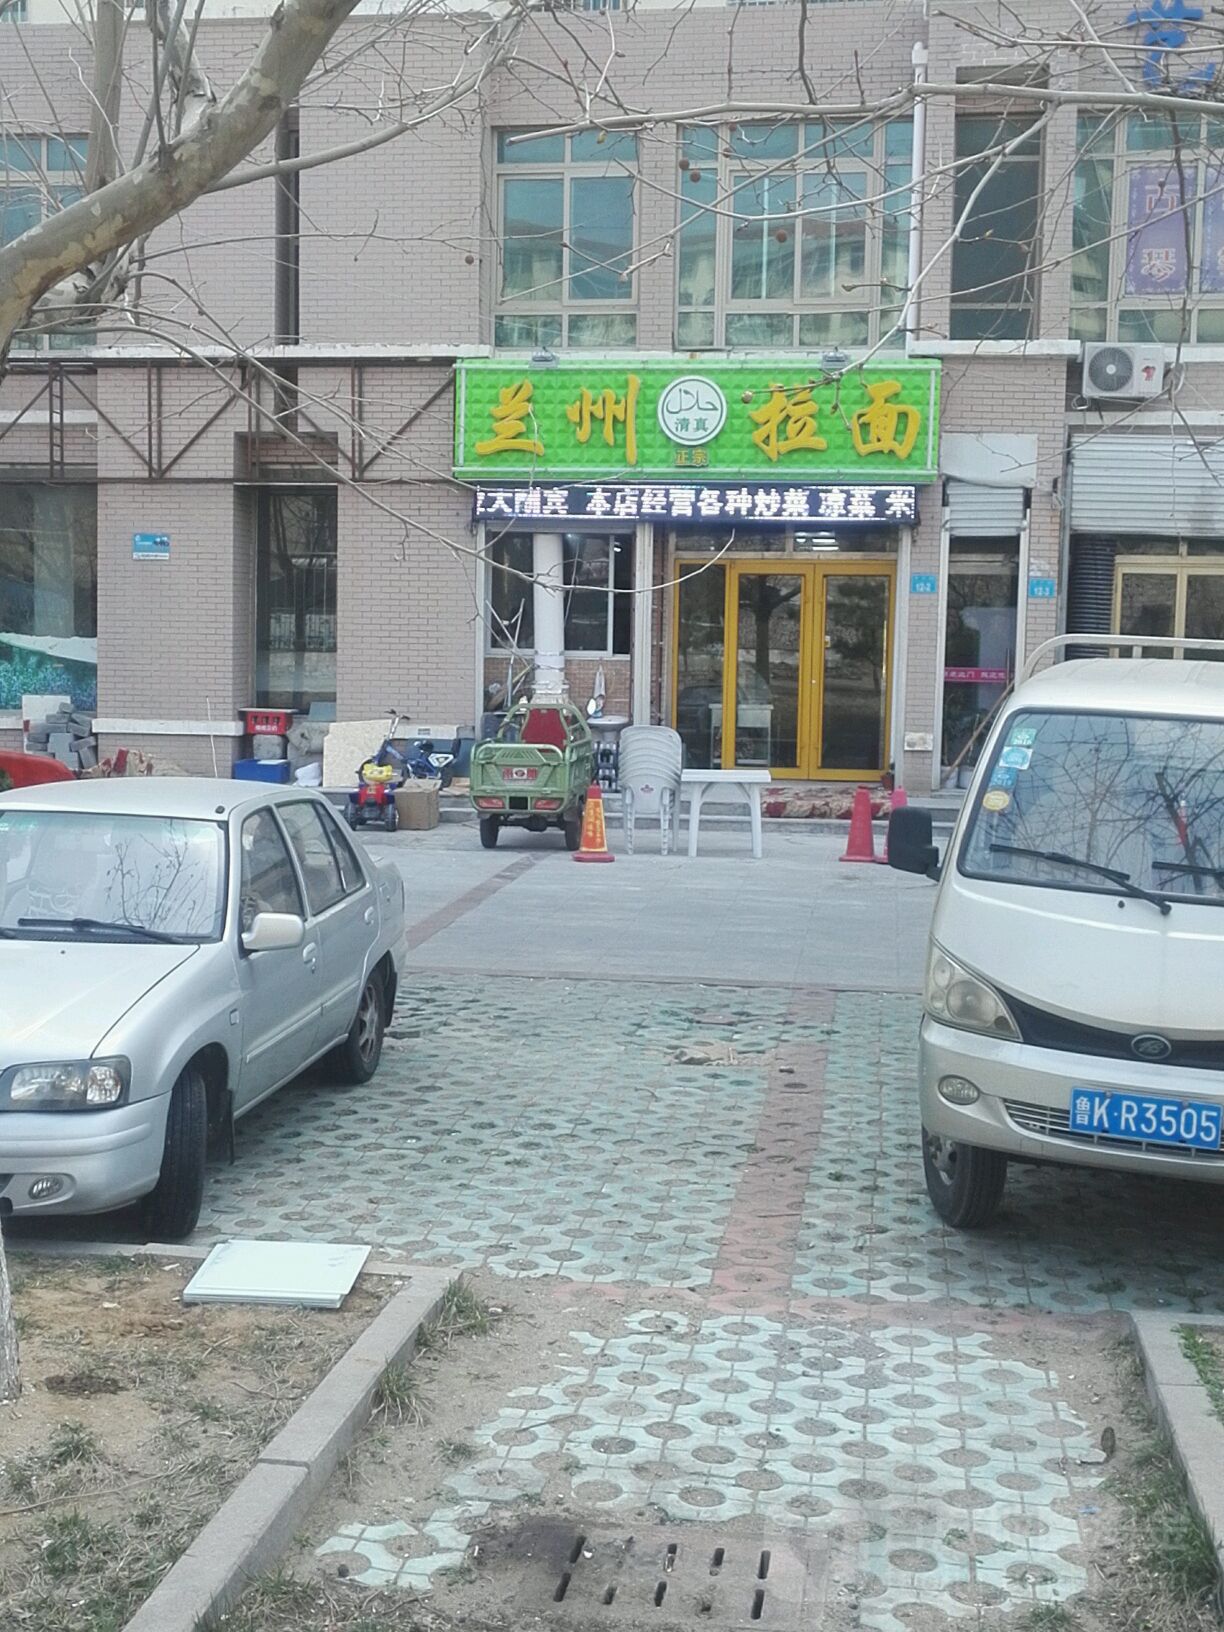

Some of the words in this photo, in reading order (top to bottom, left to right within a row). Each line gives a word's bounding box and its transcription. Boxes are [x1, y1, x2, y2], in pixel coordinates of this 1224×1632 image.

[665, 387, 719, 414] حلال
[475, 374, 640, 466] 兰州
[749, 378, 921, 463] 拉面
[674, 416, 709, 433] 清真
[674, 447, 709, 466] 正宗
[586, 487, 810, 517] 本店经营各种炒菜
